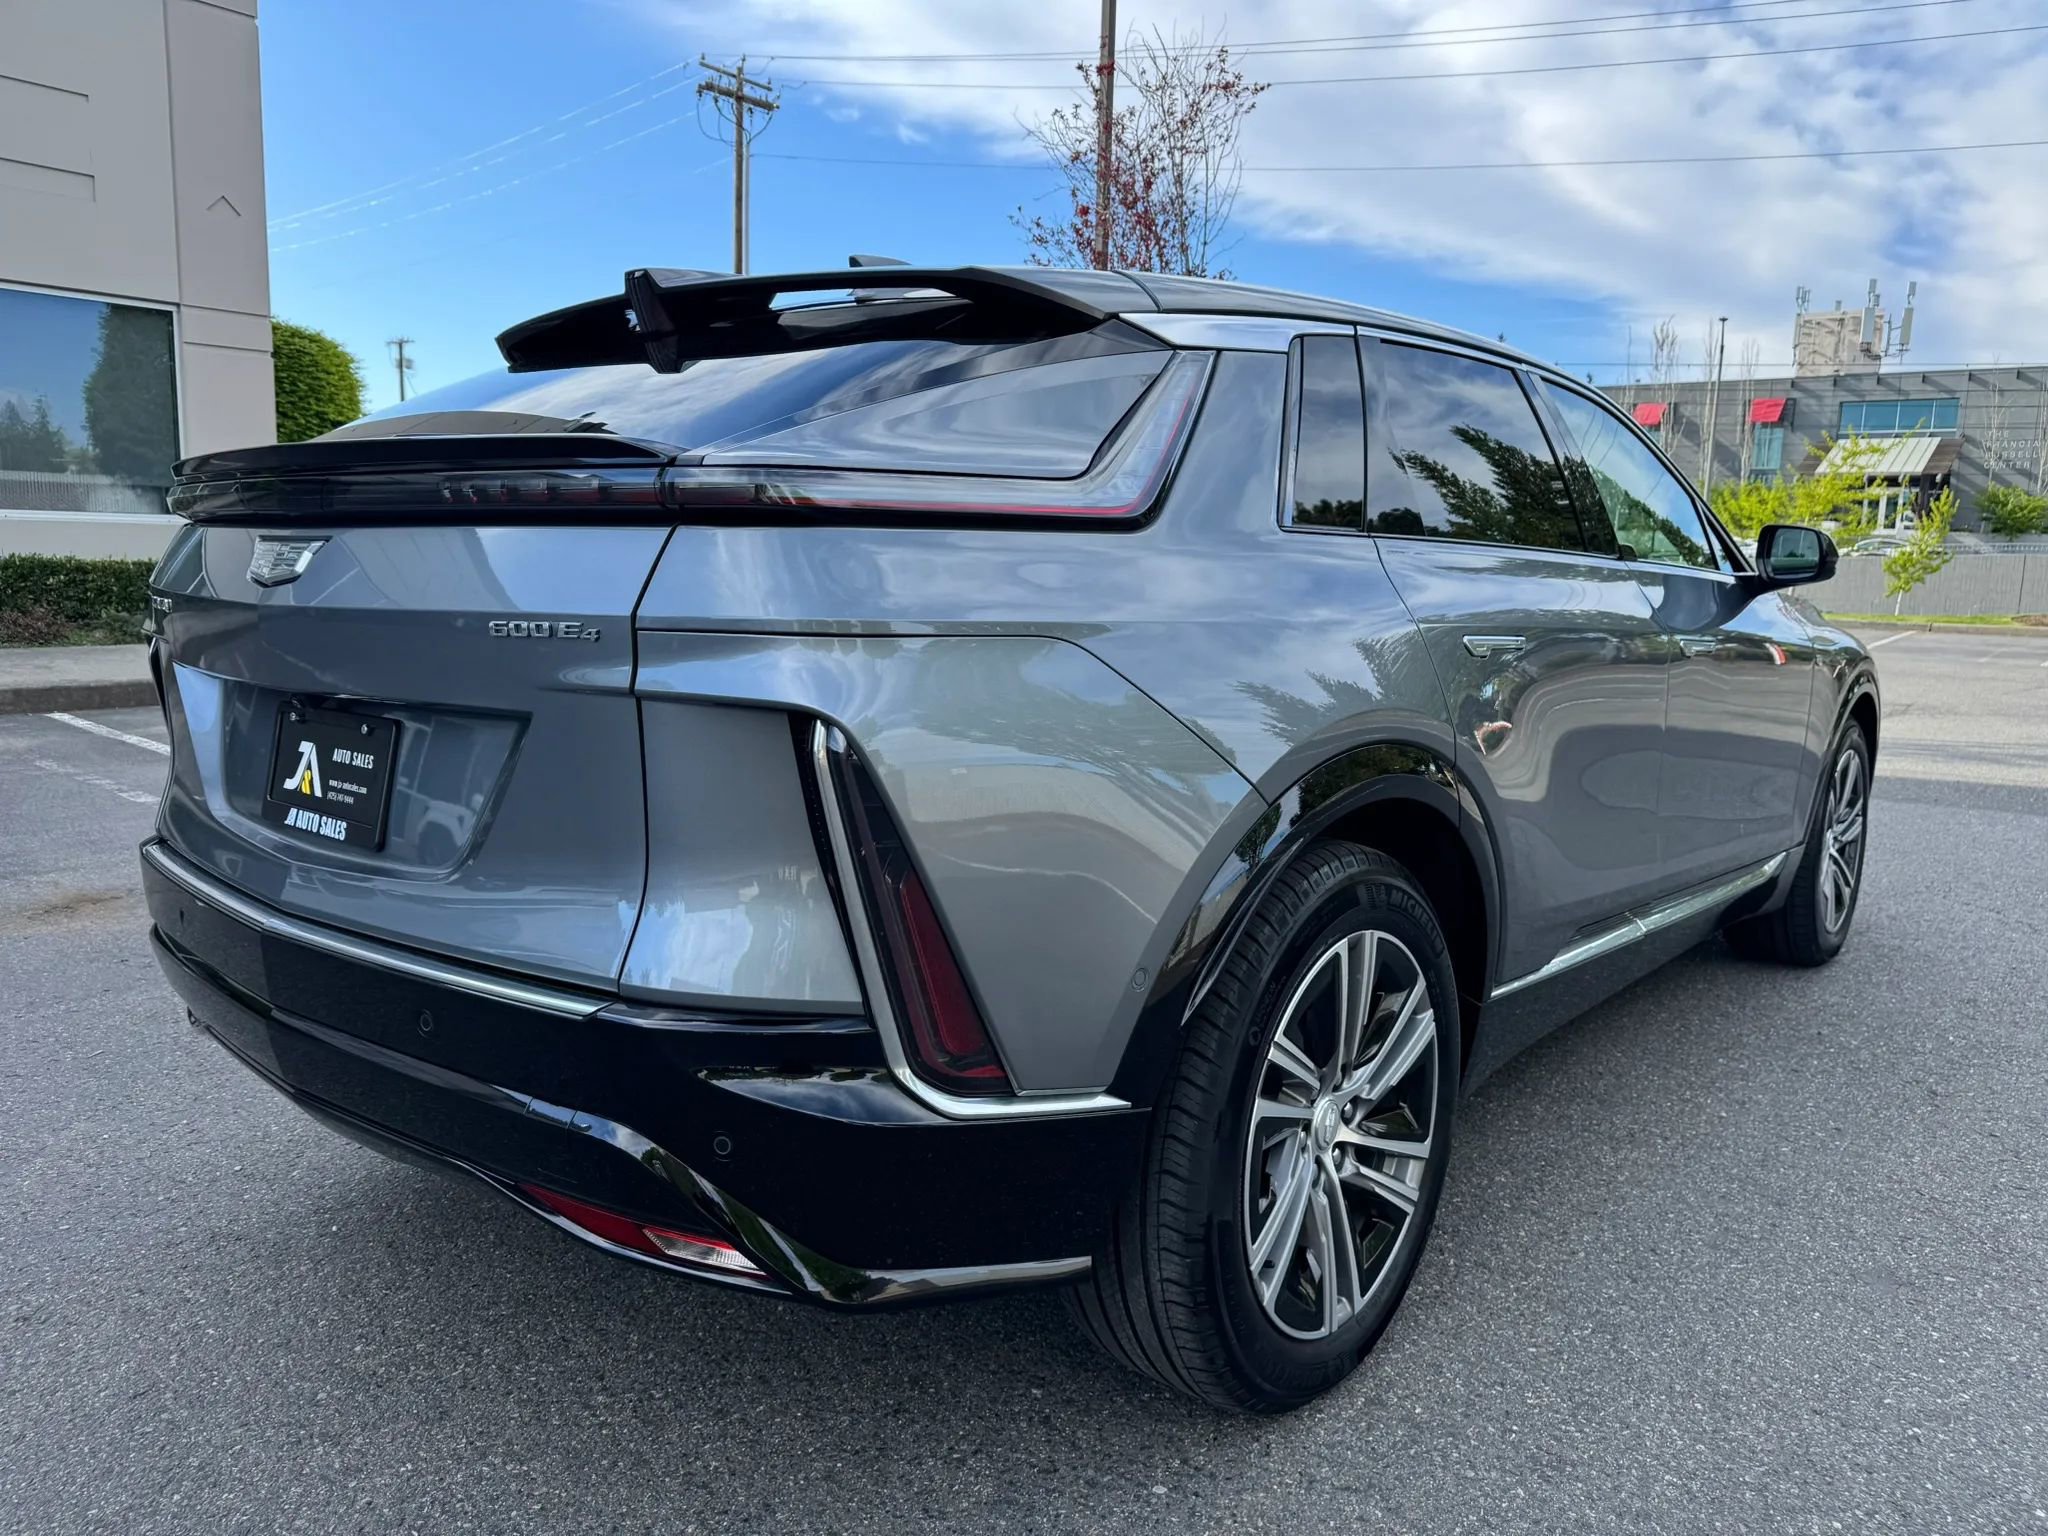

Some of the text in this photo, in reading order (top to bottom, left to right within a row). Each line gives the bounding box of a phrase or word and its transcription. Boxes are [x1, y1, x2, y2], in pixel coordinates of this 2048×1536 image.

[488, 620, 551, 638] 600
[332, 747, 374, 769] AUTO SALES
[295, 809, 320, 833] AUTO
[319, 815, 347, 841] SALES
